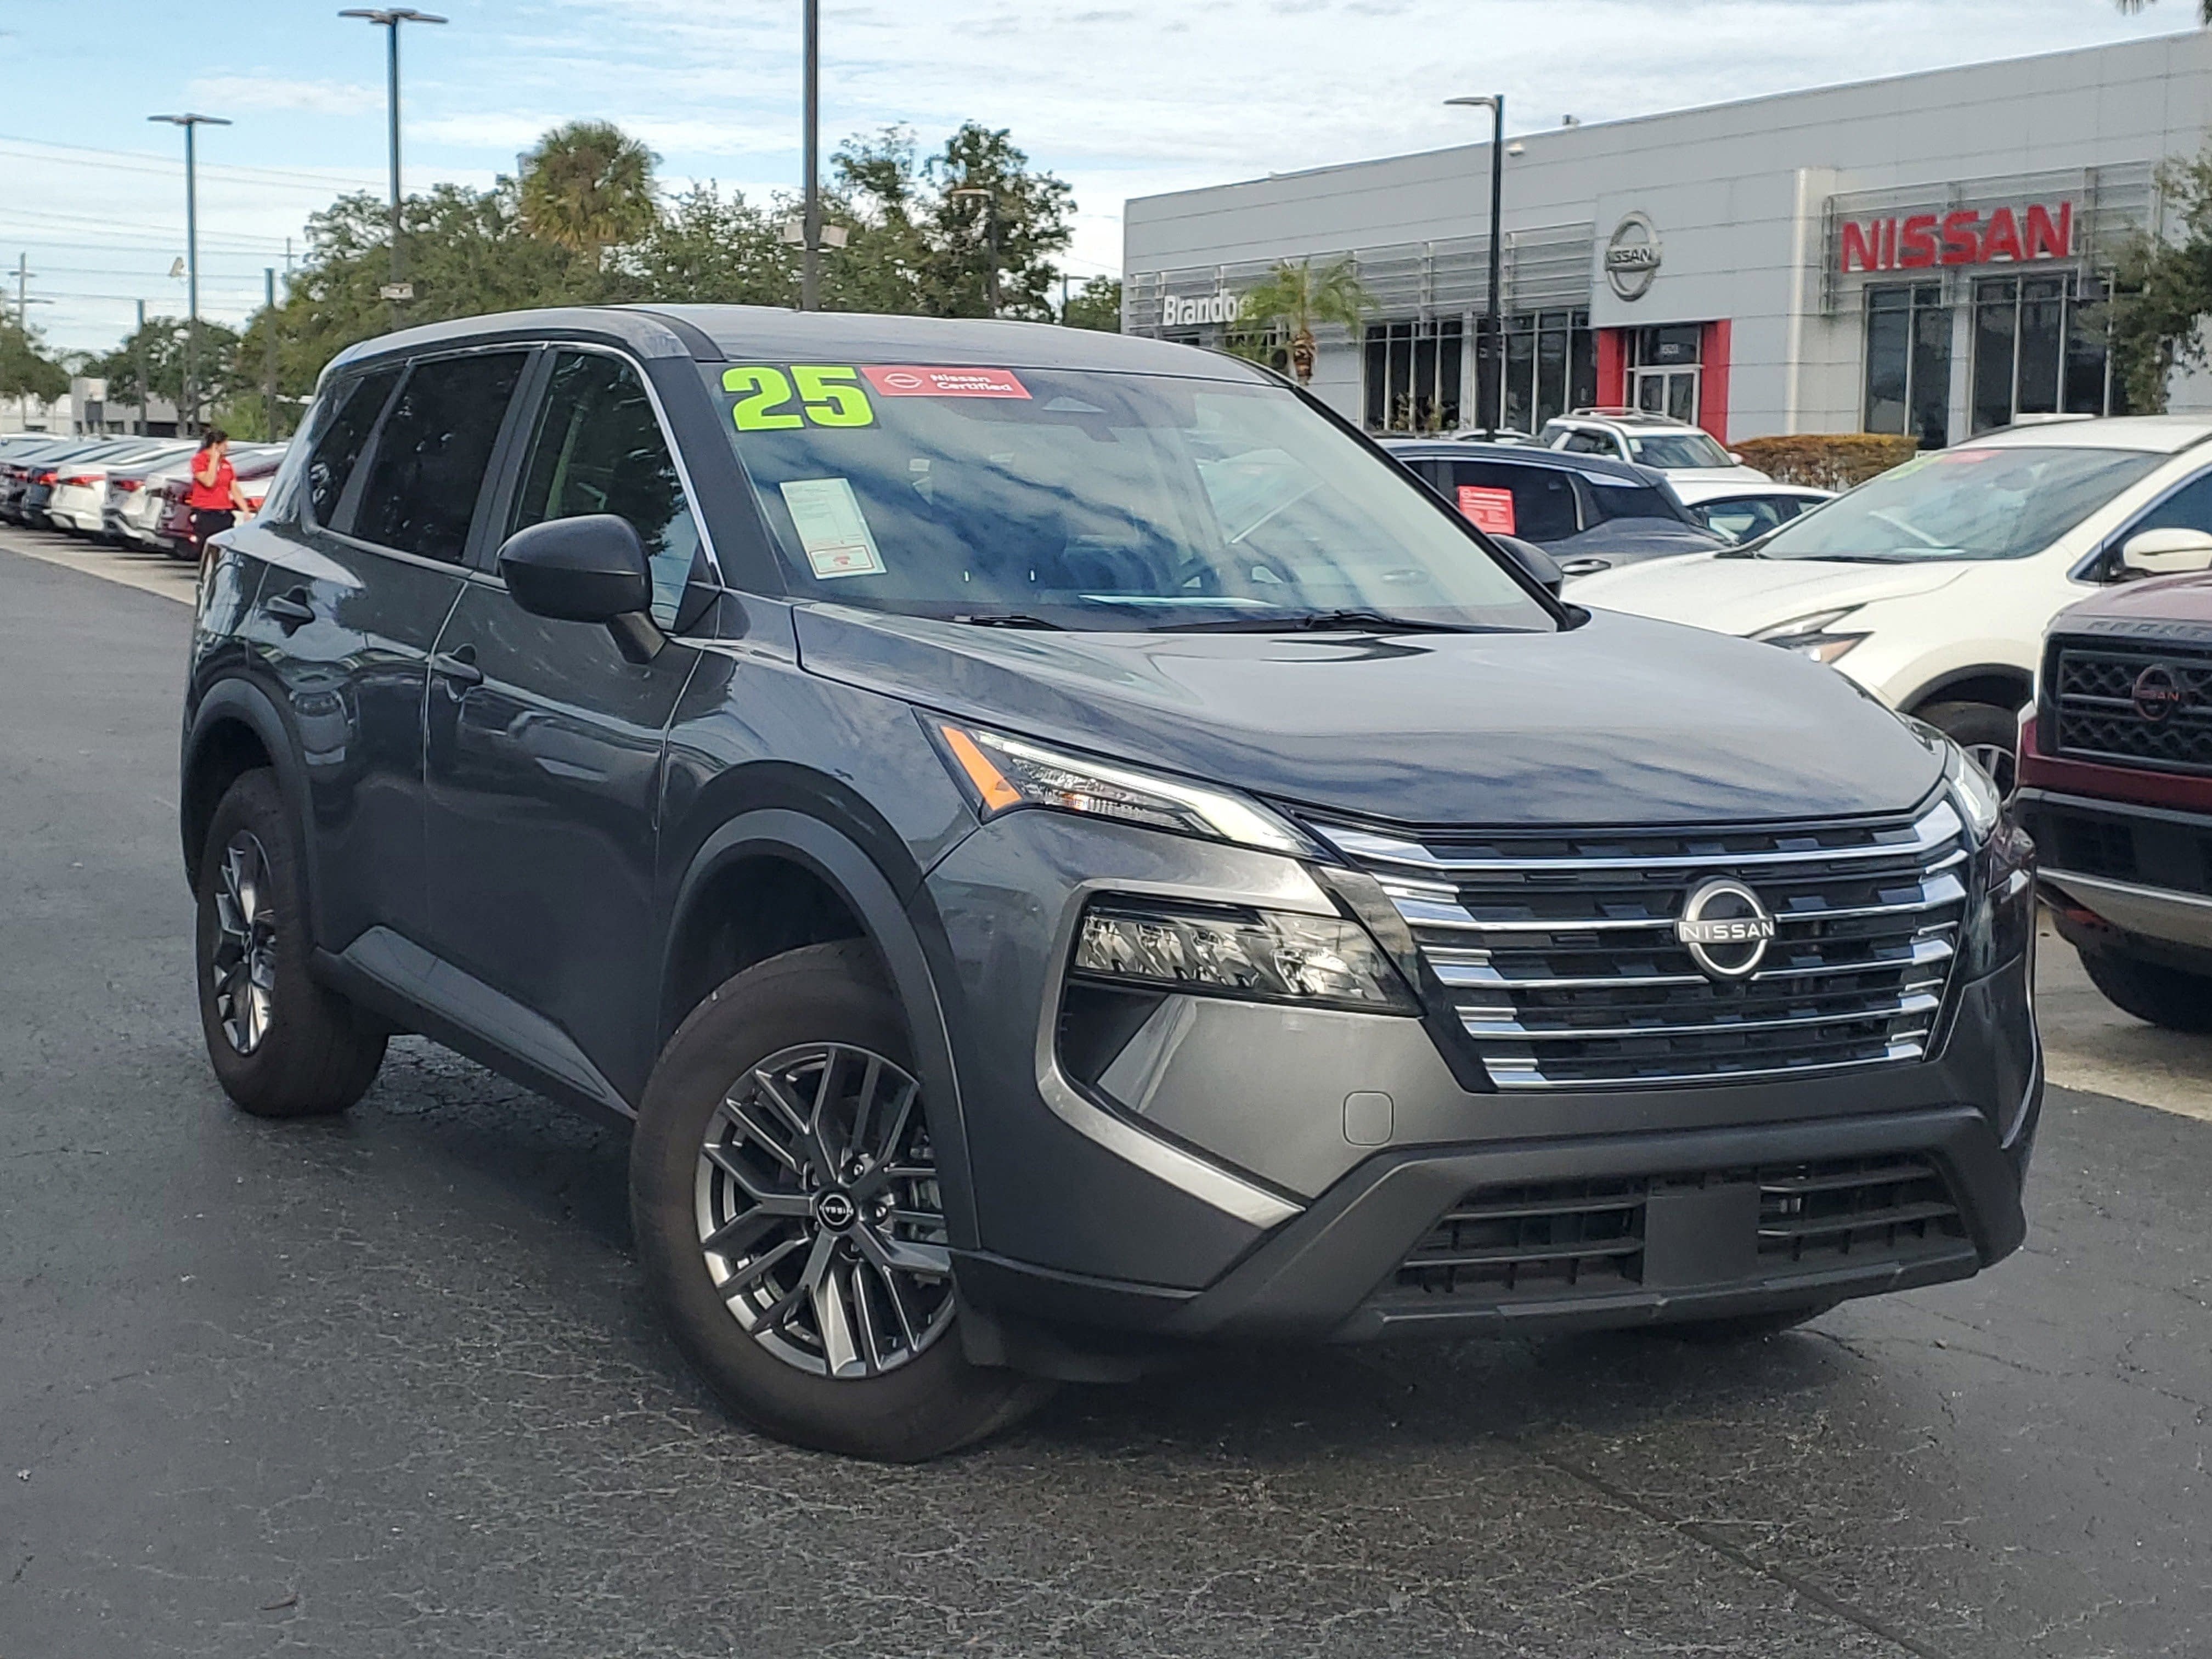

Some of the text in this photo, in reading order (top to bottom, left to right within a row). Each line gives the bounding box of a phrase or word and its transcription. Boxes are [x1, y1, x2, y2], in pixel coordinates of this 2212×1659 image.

[1841, 201, 2072, 273] NISSAN
[1607, 248, 1652, 264] SSAN
[930, 374, 992, 383] Nissan
[937, 382, 1014, 391] Certified
[721, 365, 874, 431] 25
[1678, 921, 1775, 942] NISSAN
